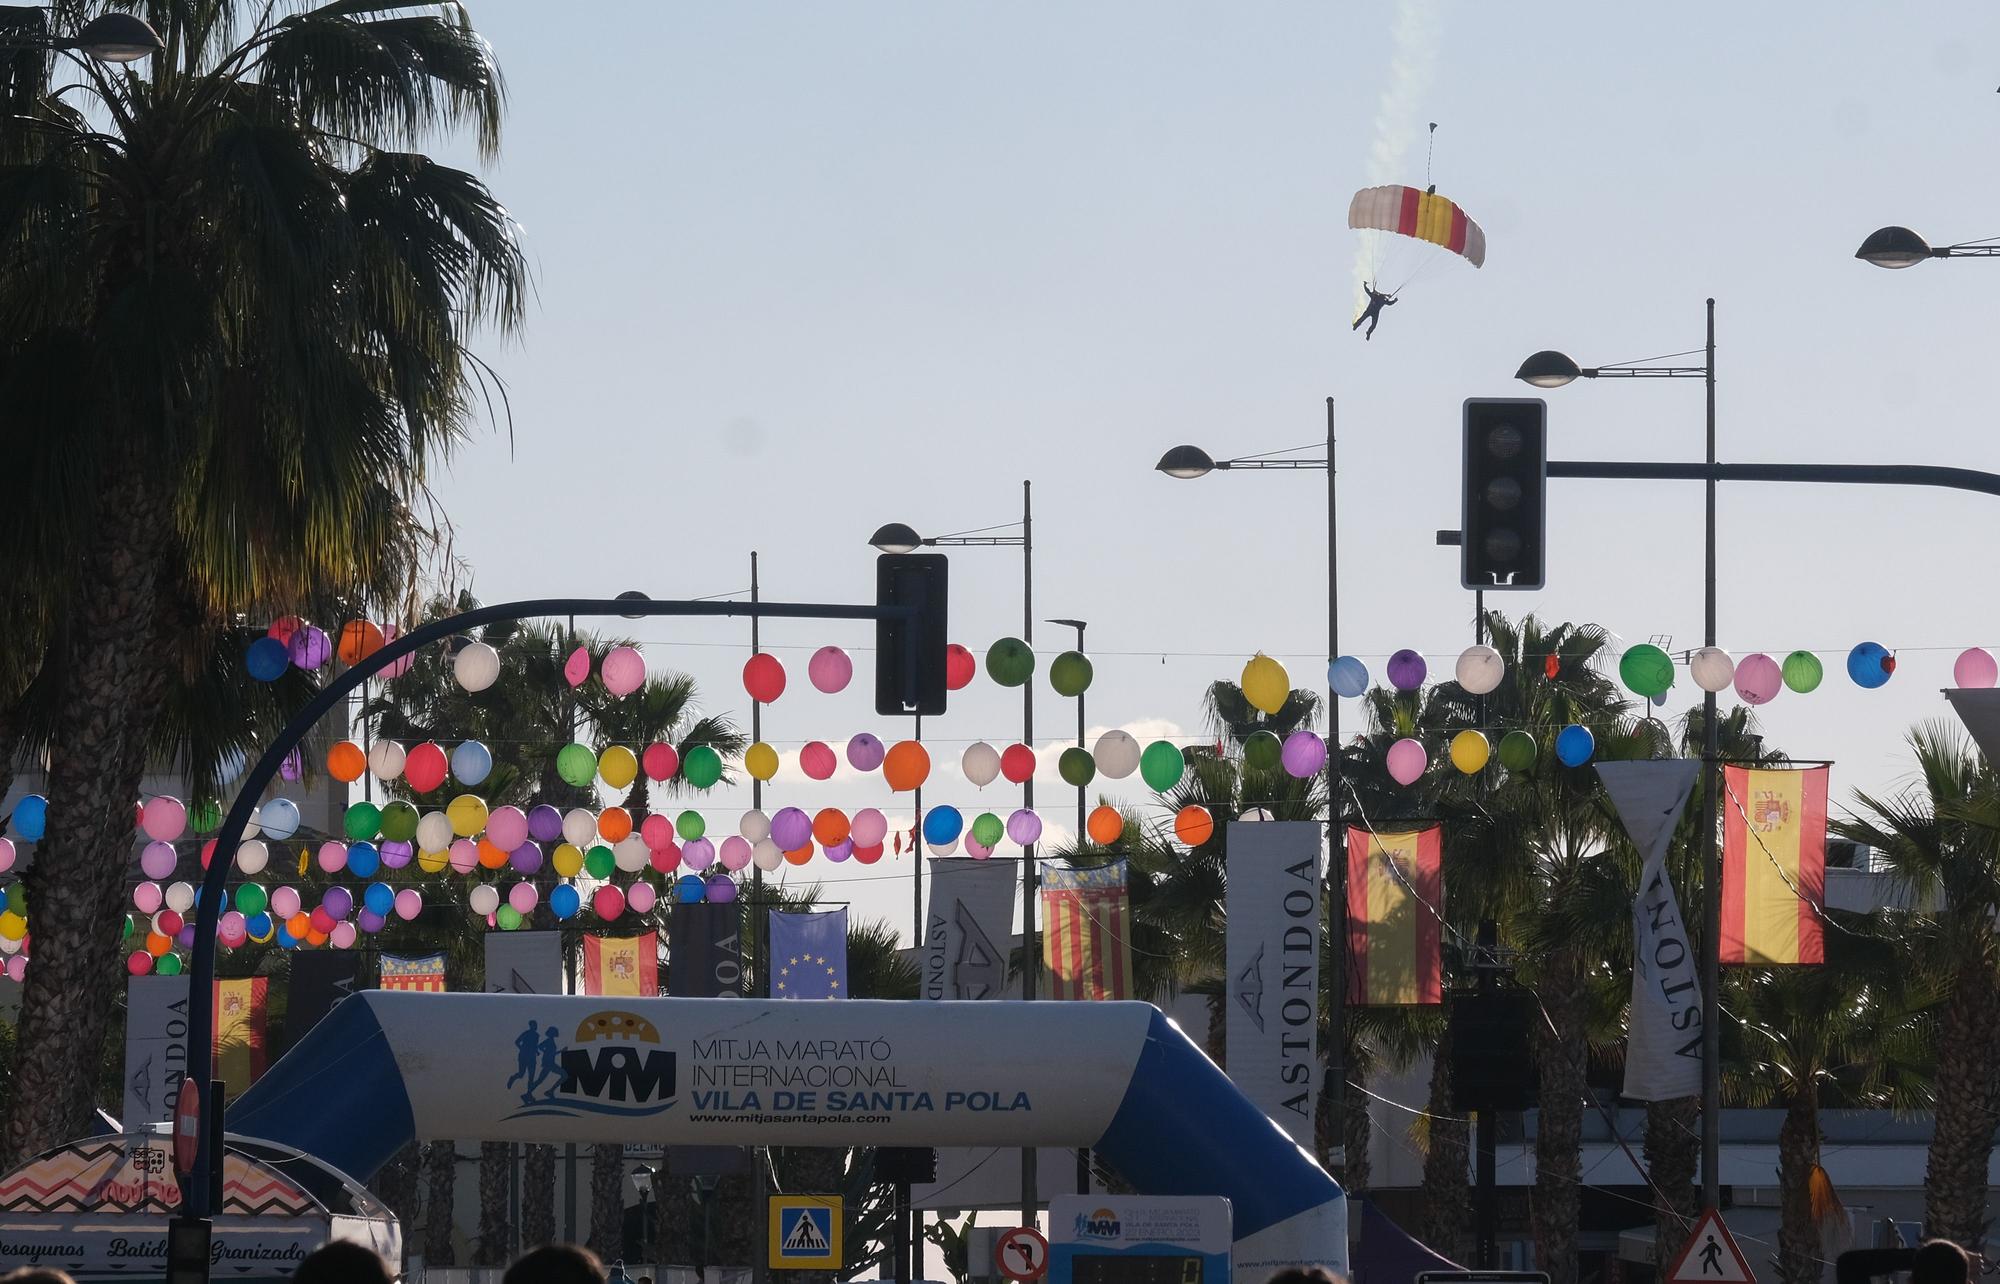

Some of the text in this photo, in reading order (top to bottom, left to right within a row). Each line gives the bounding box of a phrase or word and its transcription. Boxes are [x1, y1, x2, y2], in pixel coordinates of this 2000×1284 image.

[1280, 855, 1315, 1121] ASTONDOA
[692, 1036, 892, 1062] MITJA MARATÓ
[692, 1065, 907, 1088] INTERNACIONAL
[691, 1090, 1032, 1112] VILA DE SANTA POLA
[689, 1113, 892, 1125] www.mitjasantapola.com
[0, 1242, 85, 1263] esayunos
